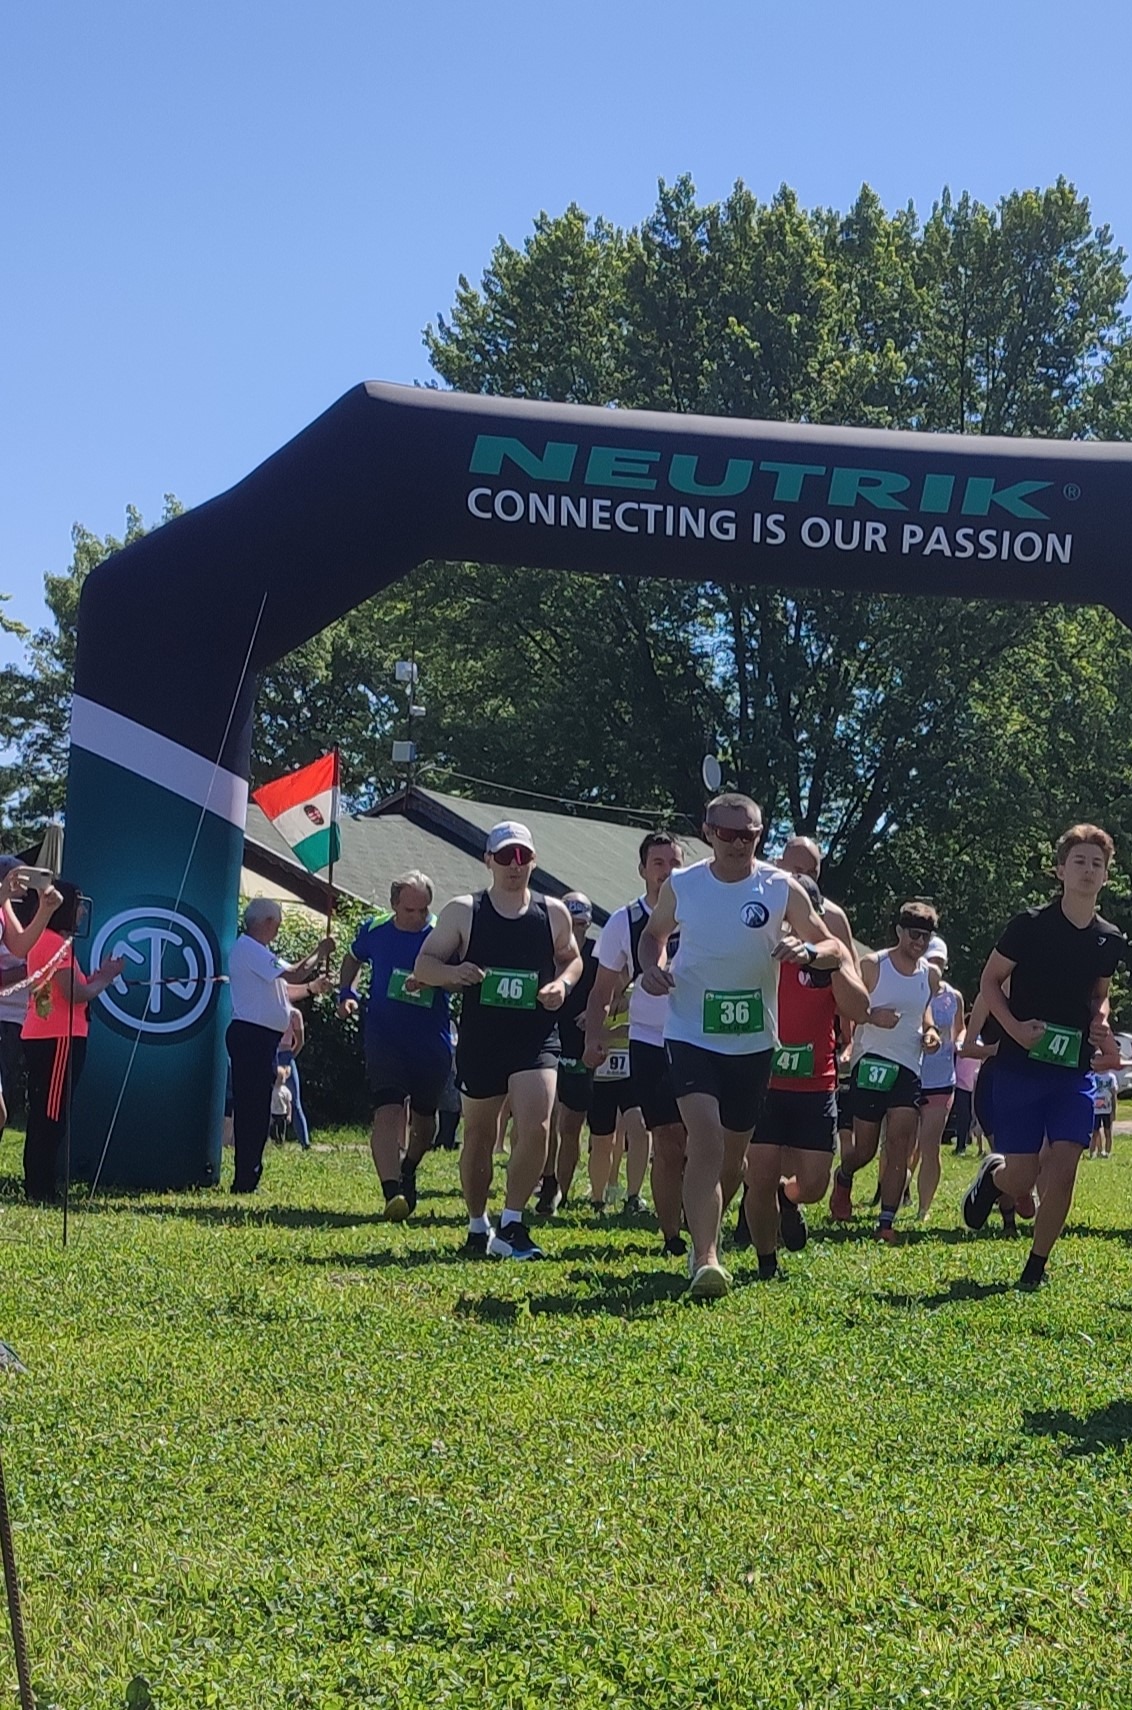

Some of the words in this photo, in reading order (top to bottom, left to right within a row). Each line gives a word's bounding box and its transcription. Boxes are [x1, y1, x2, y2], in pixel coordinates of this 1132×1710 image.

[469, 434, 1055, 520] NEUTRIK
[467, 487, 737, 541] CONNECTING
[753, 511, 787, 545] IS
[800, 516, 888, 553] OUR
[901, 523, 1073, 564] PASSION
[496, 977, 524, 999] 46
[720, 1001, 750, 1025] 36
[1048, 1034, 1070, 1056] 47
[777, 1051, 800, 1070] 41
[868, 1065, 888, 1084] 37
